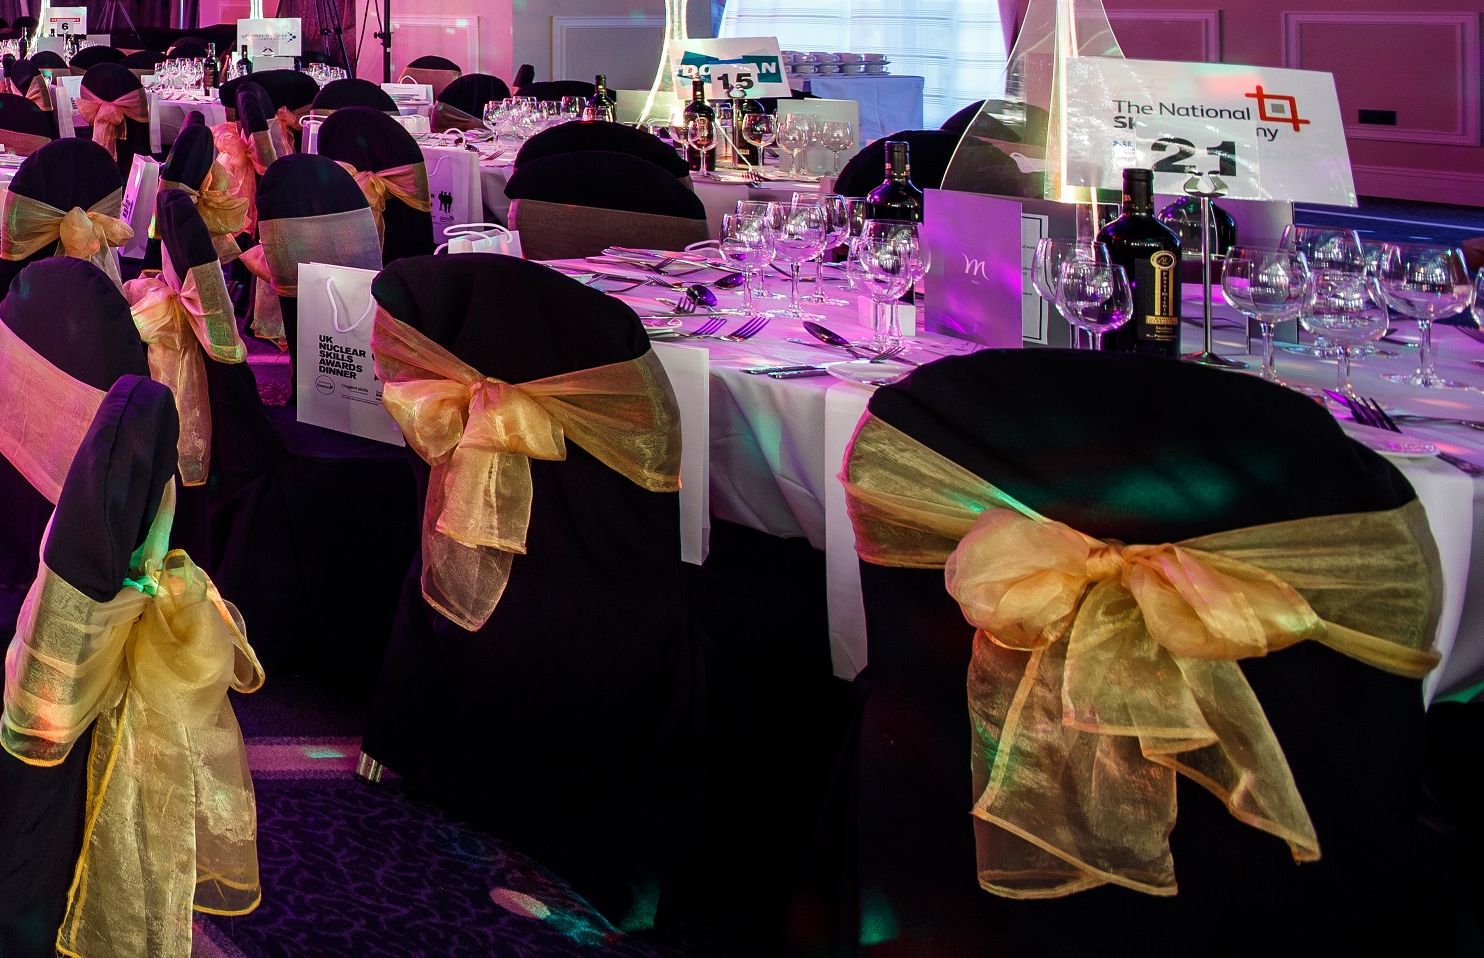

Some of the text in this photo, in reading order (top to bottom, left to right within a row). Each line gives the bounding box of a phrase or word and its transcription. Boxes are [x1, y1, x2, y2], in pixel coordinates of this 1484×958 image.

[61, 22, 69, 31] 6
[717, 72, 755, 90] 15
[1112, 99, 1251, 121] The National
[1150, 137, 1237, 177] 21
[318, 335, 334, 343] UK
[318, 342, 367, 358] NUCLEAR
[318, 350, 354, 363] SKILLS
[318, 358, 363, 373] AWARDS
[318, 365, 357, 380] DINNER
